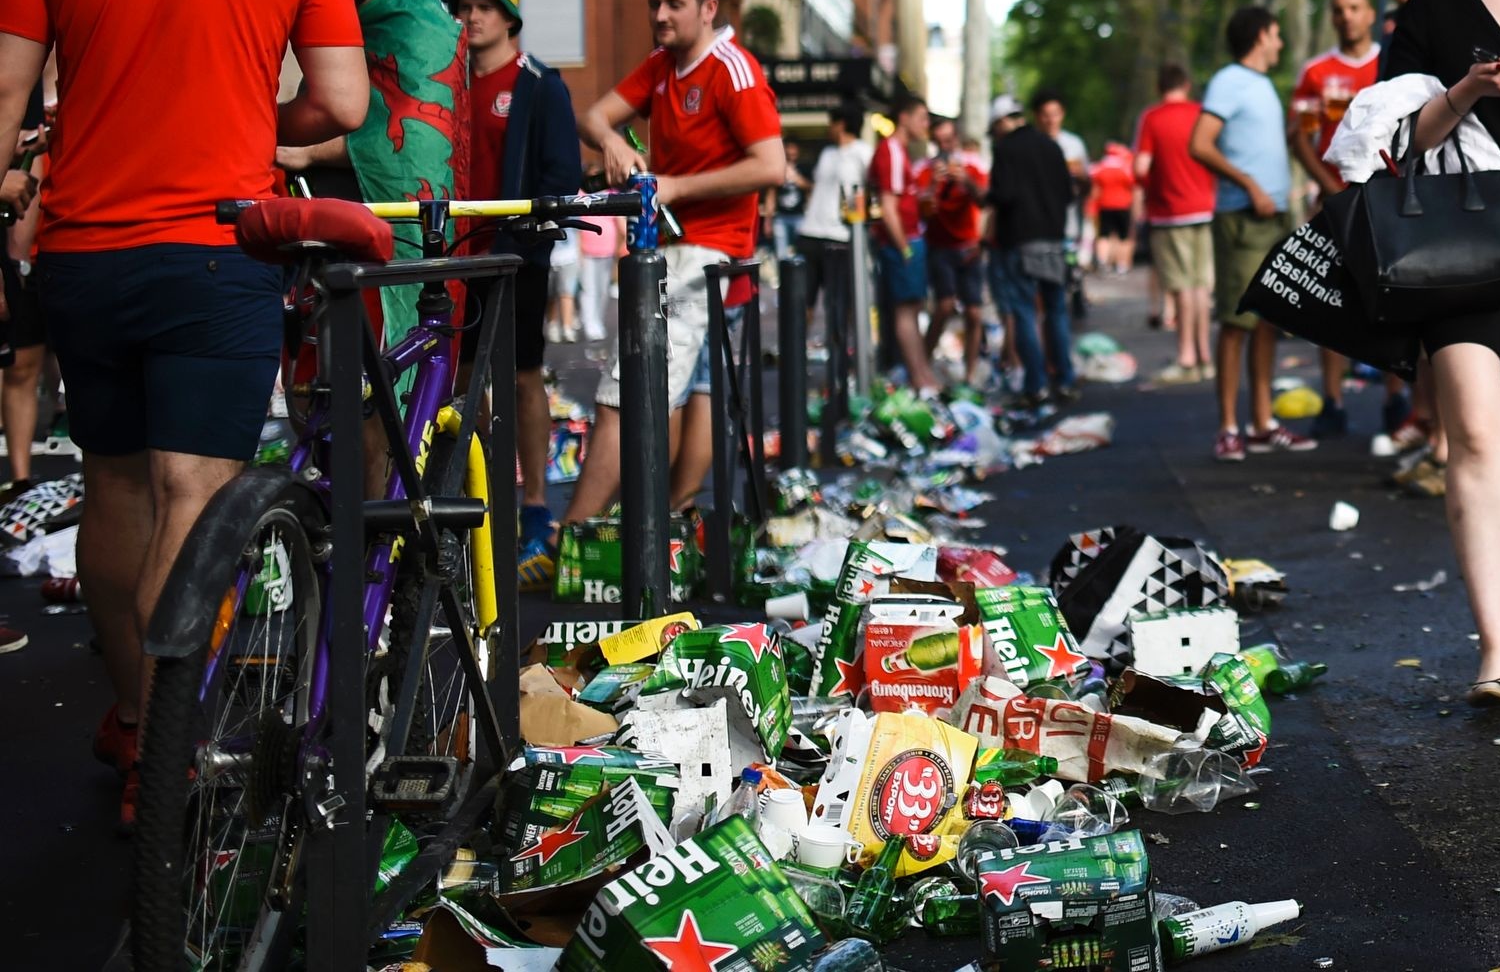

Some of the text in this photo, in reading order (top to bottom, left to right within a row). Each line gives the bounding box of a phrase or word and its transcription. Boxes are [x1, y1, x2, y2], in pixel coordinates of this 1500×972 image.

[1271, 253, 1343, 308] Sashimi&
[1282, 236, 1331, 278] Maki&
[1260, 269, 1302, 309] More.
[870, 679, 955, 705] Kronenbourg
[883, 771, 902, 824] EXPORT
[602, 838, 721, 917] Hein
